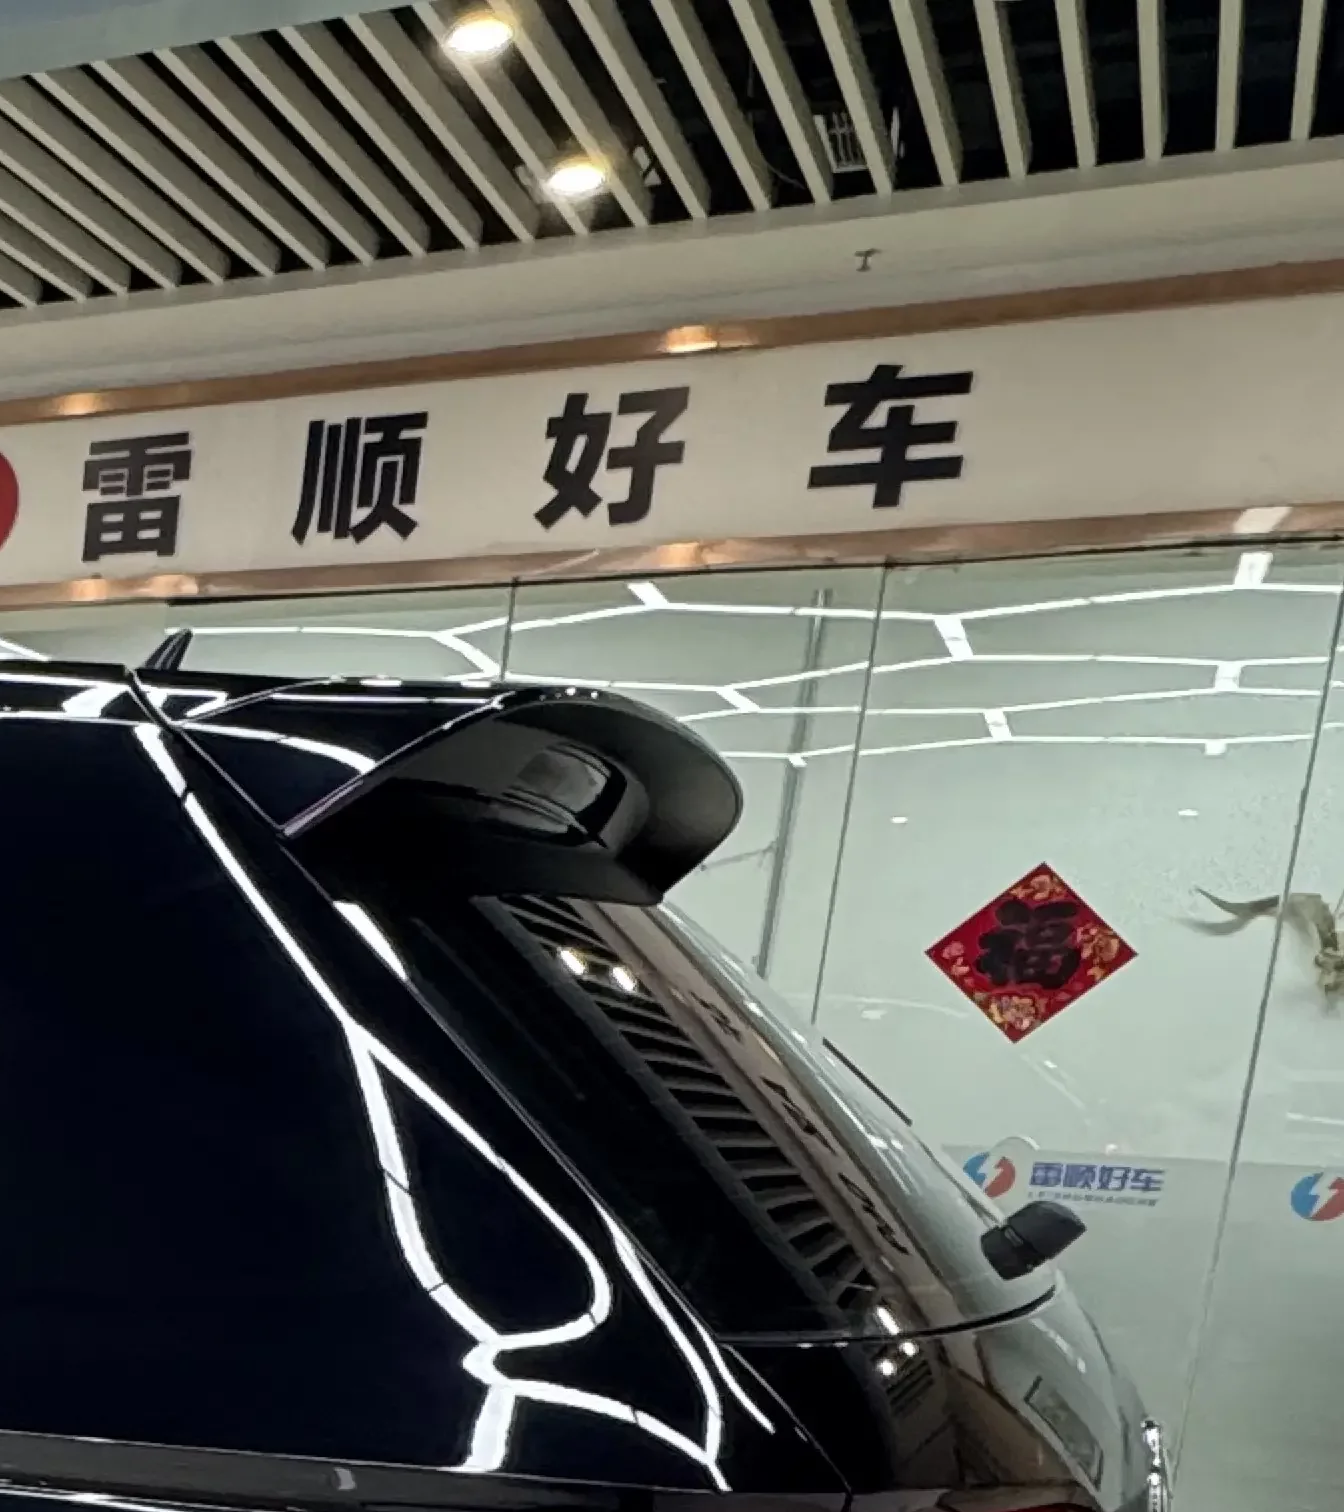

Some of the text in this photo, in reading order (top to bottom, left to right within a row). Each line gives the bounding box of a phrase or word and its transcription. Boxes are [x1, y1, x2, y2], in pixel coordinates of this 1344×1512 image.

[80, 363, 975, 563] 雷顺好车
[975, 898, 1082, 990] 福
[1028, 1161, 1166, 1193] 雷顺好车
